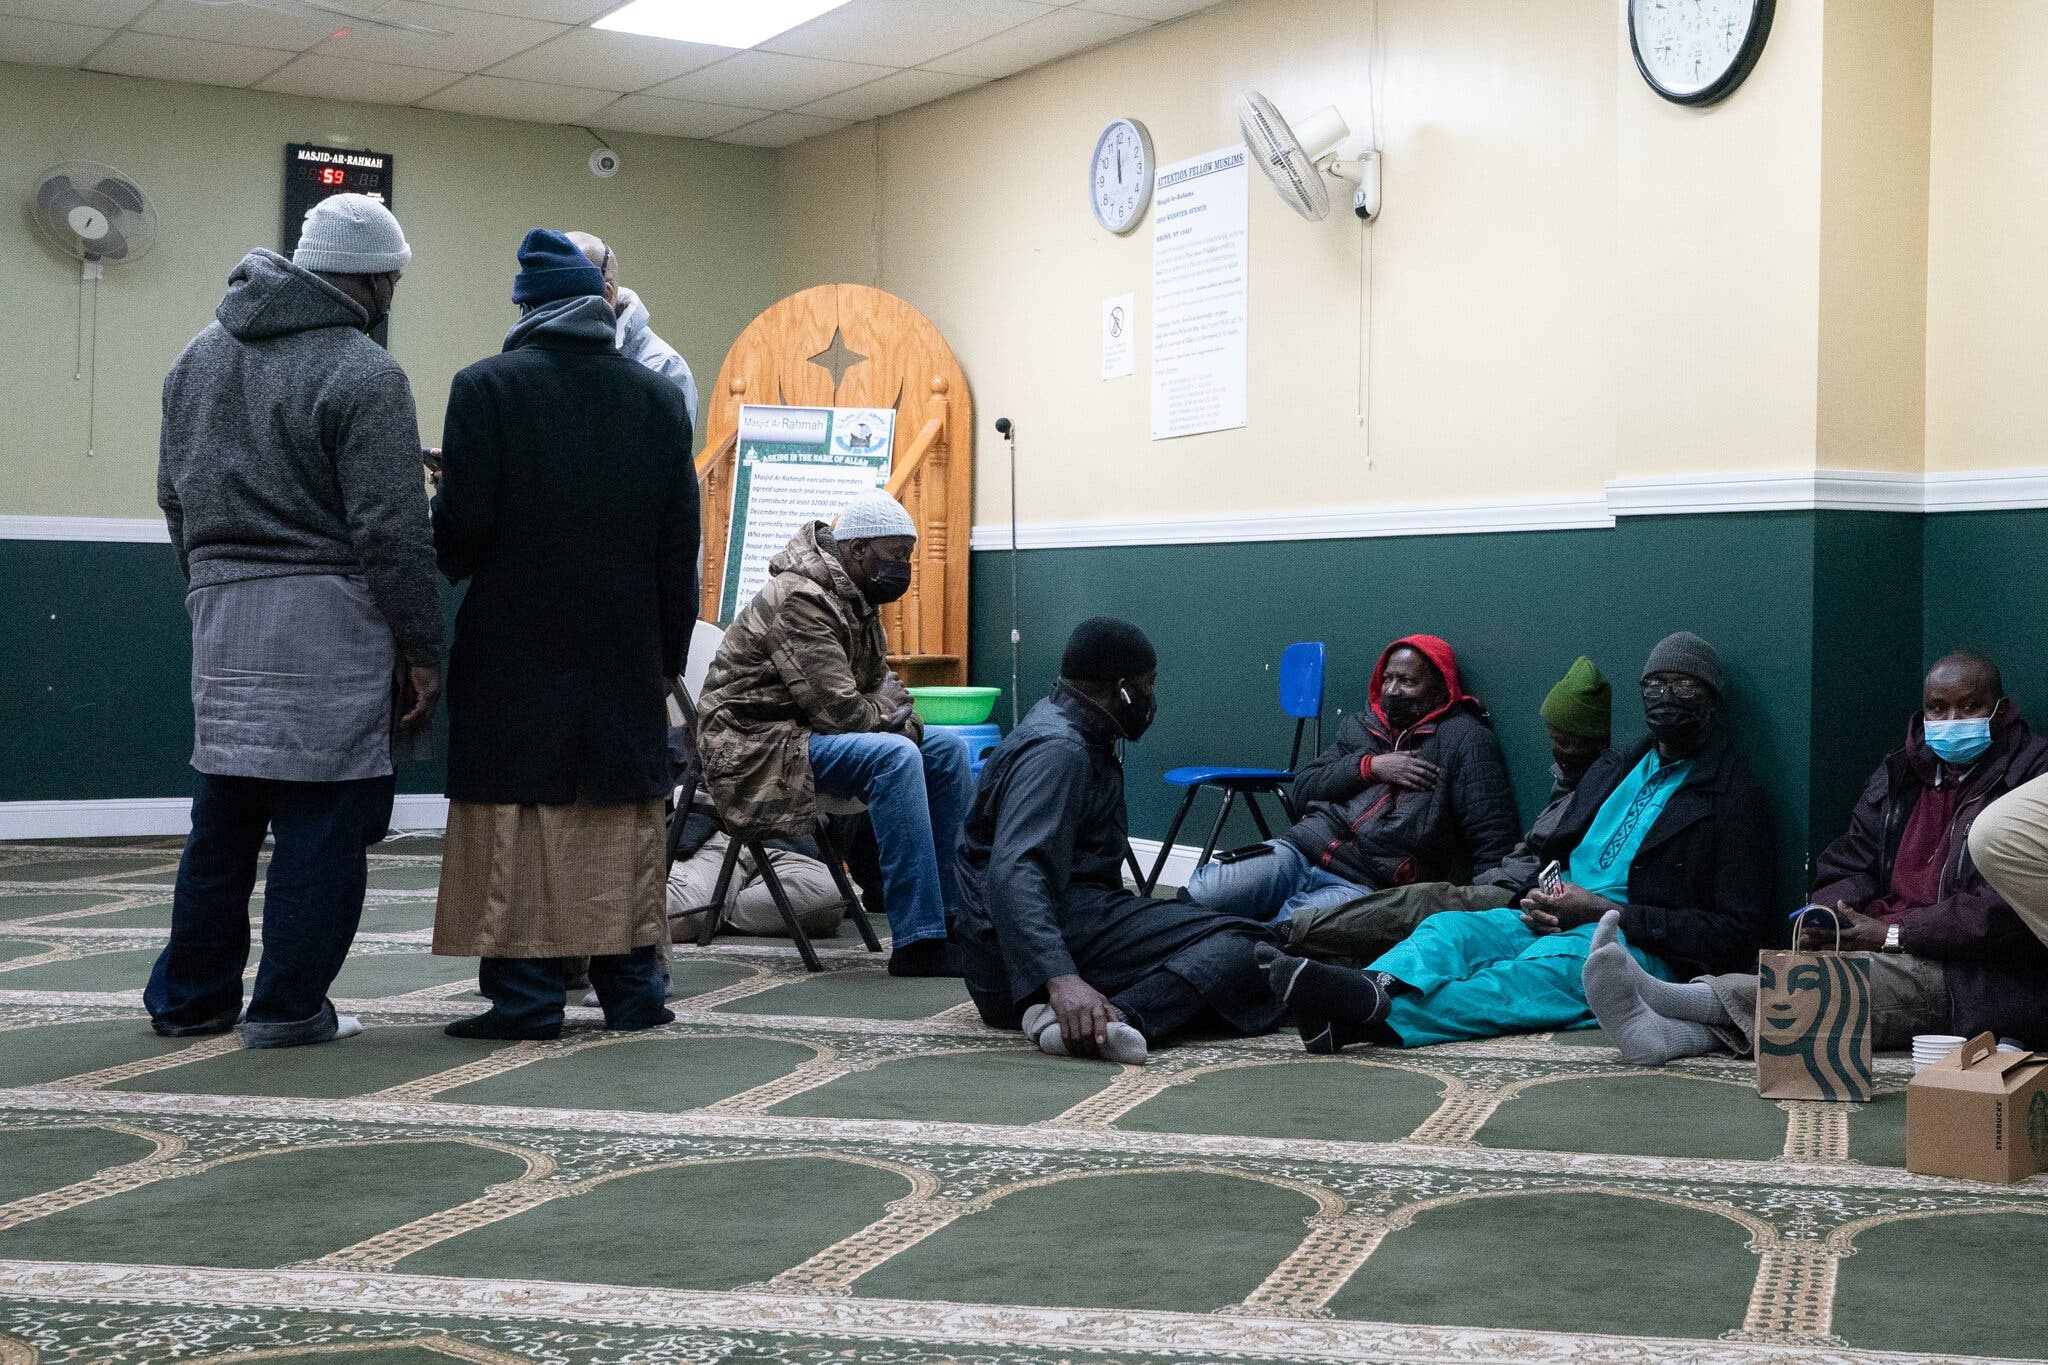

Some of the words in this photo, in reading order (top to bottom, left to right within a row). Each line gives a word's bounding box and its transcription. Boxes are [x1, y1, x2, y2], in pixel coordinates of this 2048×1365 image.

[1133, 146, 1139, 158] 2
[1137, 162, 1142, 175] 3
[1157, 169, 1188, 187] ATTENTION
[1189, 161, 1213, 178] FELLOW
[1100, 175, 1105, 188] 9
[1103, 193, 1108, 205] 8
[1119, 205, 1124, 218] 6
[744, 417, 769, 429] Masjid
[770, 419, 782, 429] Ar
[782, 417, 824, 431] Rahmah
[762, 453, 789, 464] ASKING
[790, 453, 798, 462] IN
[799, 453, 811, 463] THE
[812, 454, 832, 464] NAME
[833, 455, 843, 465] OF
[754, 473, 773, 482] Masjid
[782, 474, 806, 482] Rahmah
[807, 476, 836, 484] executives
[836, 477, 863, 485] members
[752, 486, 772, 495] agreed
[773, 488, 788, 496] upon
[789, 487, 803, 495] each
[803, 488, 815, 496] and
[759, 497, 788, 506] contribute
[750, 508, 779, 516] December
[779, 509, 788, 518] for
[799, 510, 823, 519] purchase
[824, 511, 833, 519] of
[758, 521, 784, 529] currently
[763, 543, 773, 551] for
